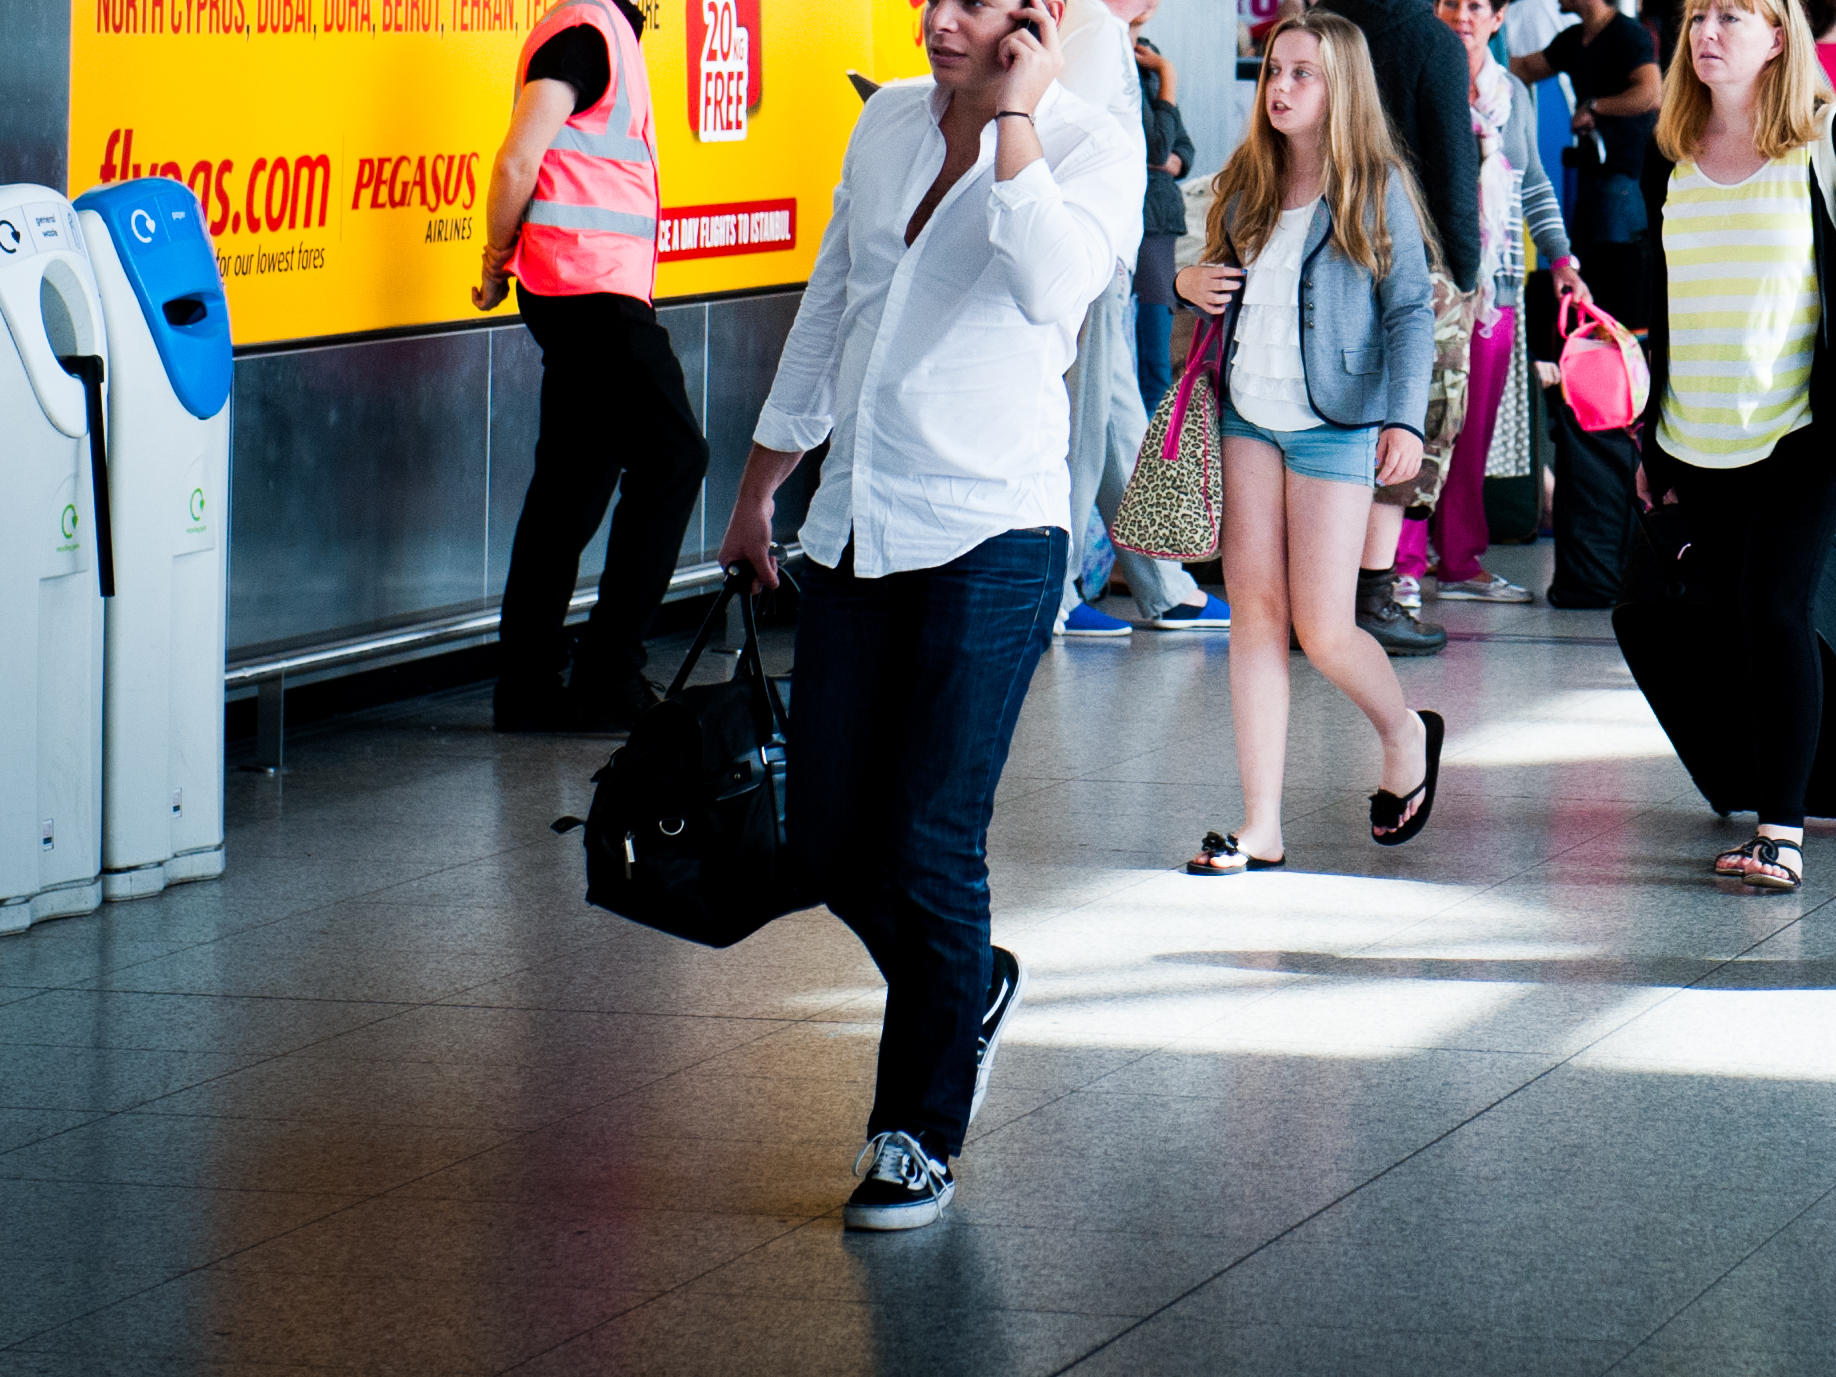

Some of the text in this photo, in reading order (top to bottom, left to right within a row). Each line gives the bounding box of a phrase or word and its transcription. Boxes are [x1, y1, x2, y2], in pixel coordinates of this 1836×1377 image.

[705, 1, 732, 62] 20
[705, 71, 744, 132] FREE
[352, 152, 480, 212] PEGASUS
[425, 217, 473, 244] AIRLINES
[672, 218, 680, 251] A
[681, 217, 699, 250] DAY
[700, 214, 737, 248] FLIGHTS
[737, 213, 749, 245] TO
[750, 210, 791, 243] ISTANBUL
[215, 240, 325, 278] for our lowest fares
